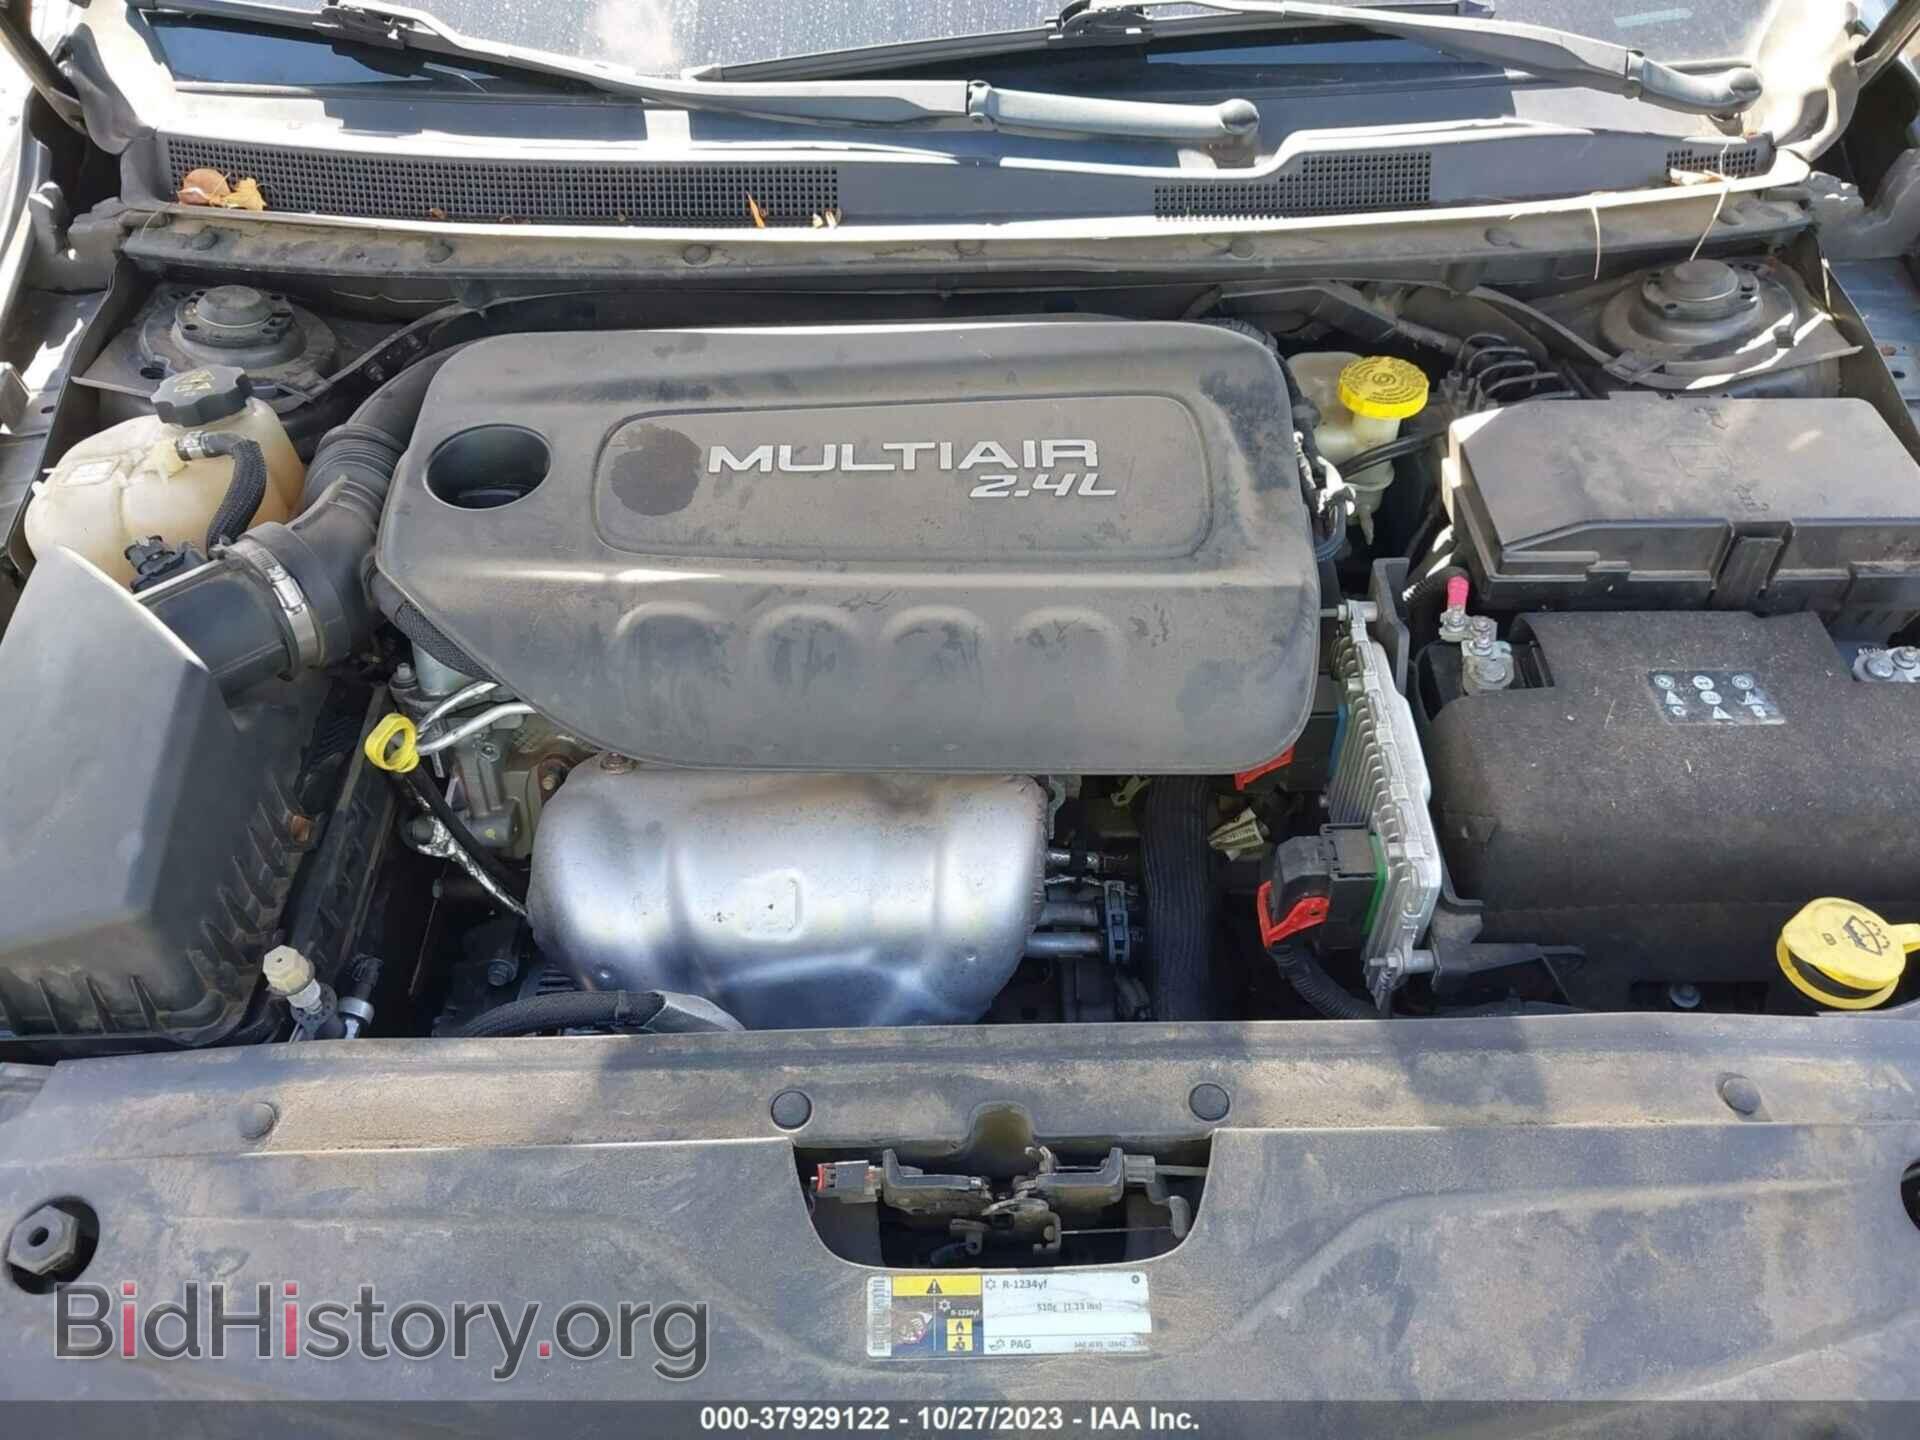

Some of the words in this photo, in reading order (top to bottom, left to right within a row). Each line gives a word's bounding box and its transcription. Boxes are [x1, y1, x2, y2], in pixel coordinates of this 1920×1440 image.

[707, 439, 1099, 473] MULTIAIR
[969, 472, 1118, 498] 2.4L
[1002, 1279, 1048, 1290] R-1234yf
[1010, 1339, 1032, 1349] PAG
